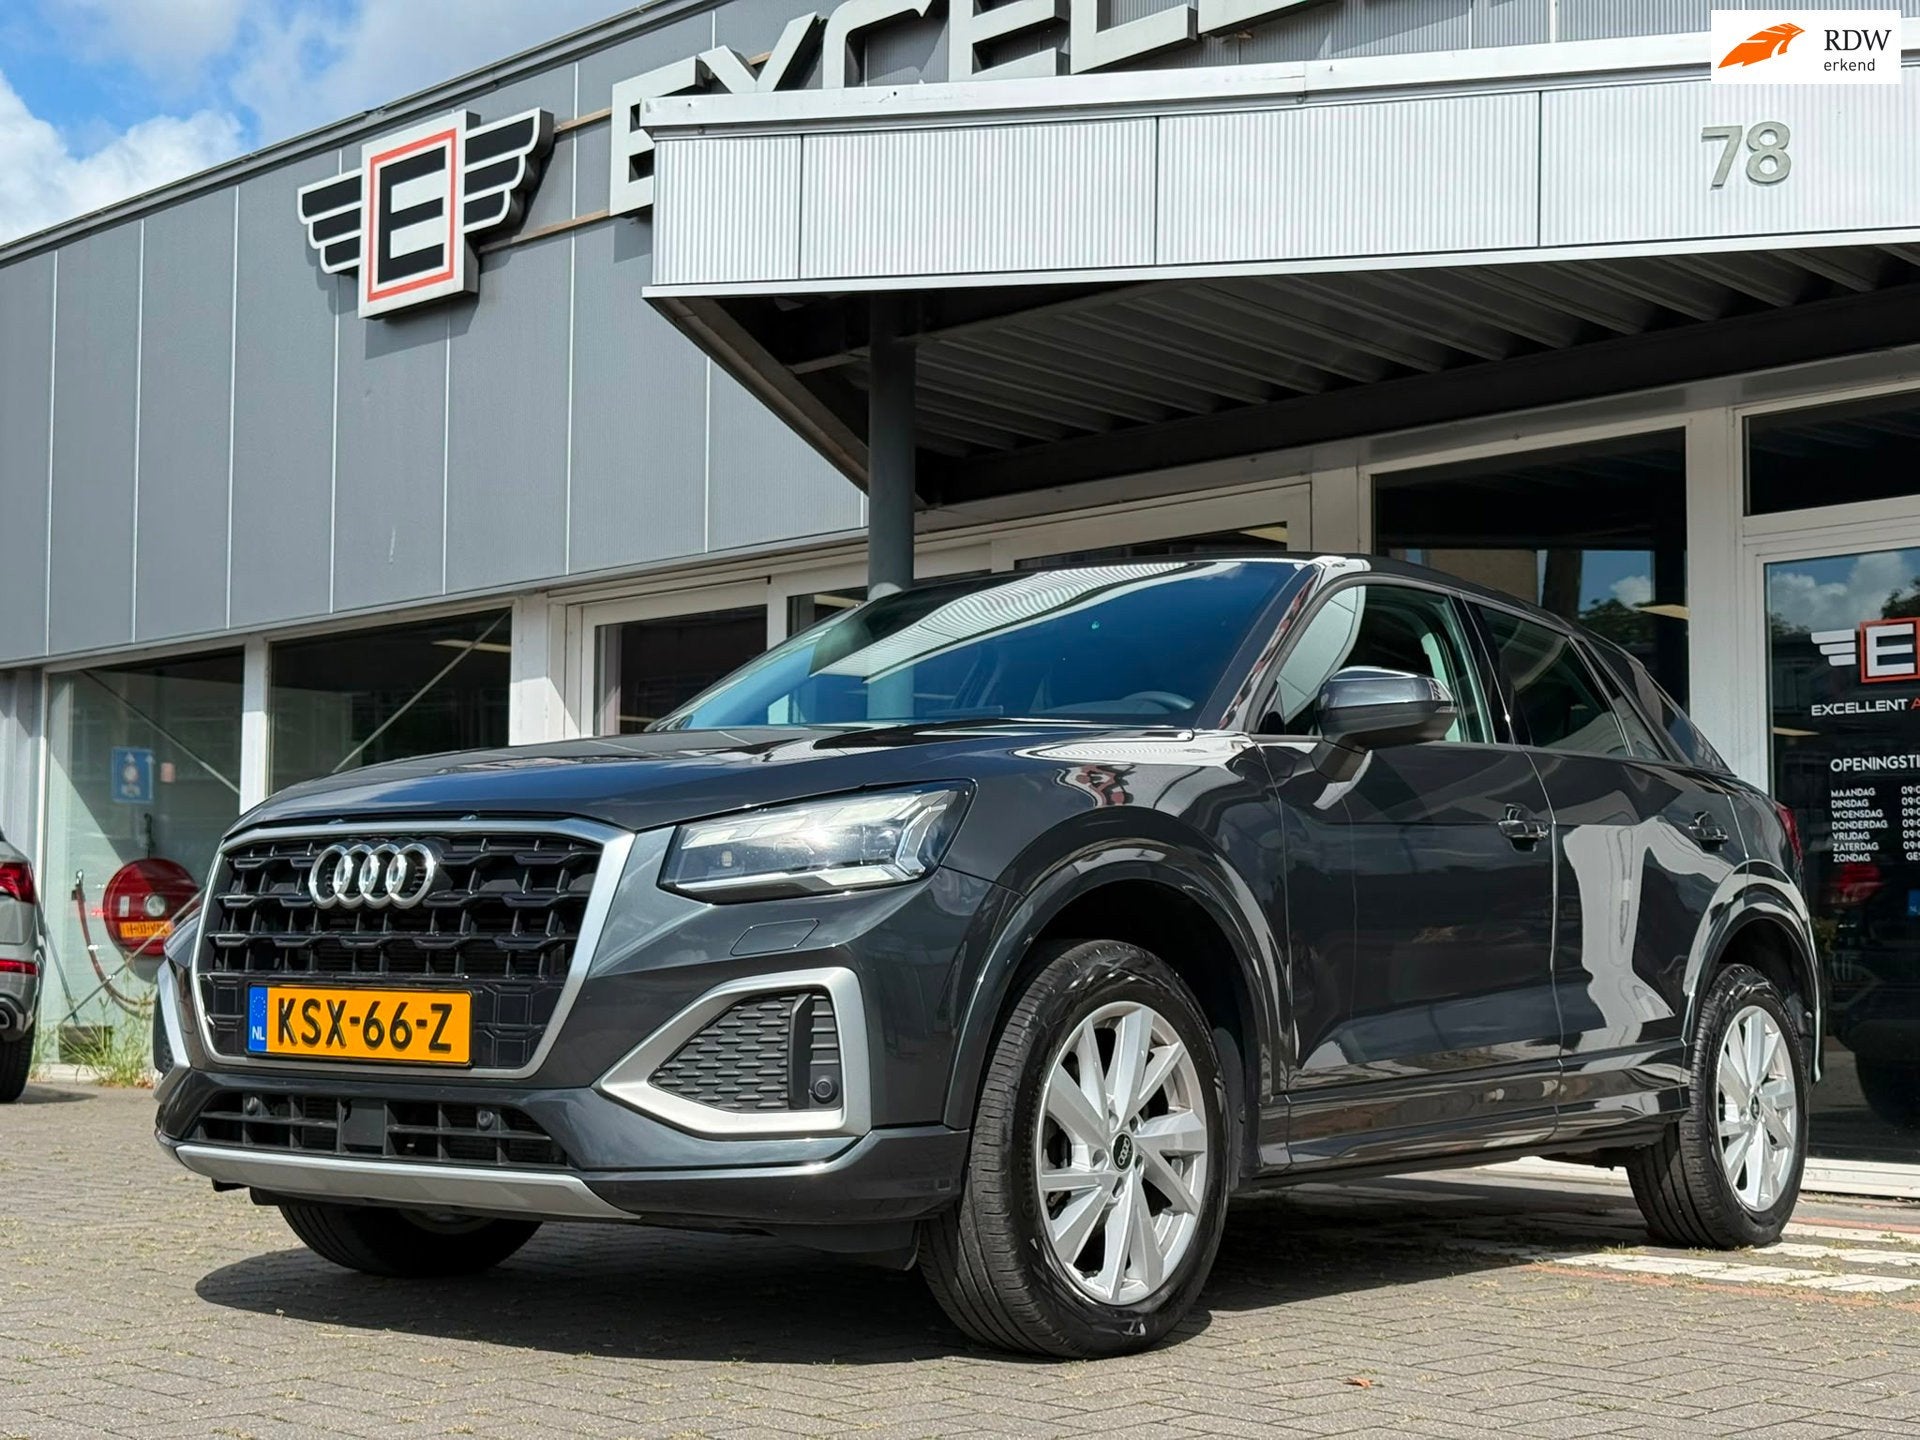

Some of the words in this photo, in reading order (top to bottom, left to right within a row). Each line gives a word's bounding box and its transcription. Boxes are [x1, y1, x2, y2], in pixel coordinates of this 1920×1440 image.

[1701, 121, 1792, 190] 78
[376, 145, 447, 285] E
[1866, 623, 1915, 677] E
[1811, 698, 1909, 716] EXCELLENT
[1830, 787, 1876, 797] MAANDAG
[1831, 798, 1869, 808] DINSDAG
[1831, 809, 1884, 819] WOENSDAG
[1831, 820, 1888, 830] DONDERDAG
[1832, 831, 1870, 841] VRIJDAG
[1832, 842, 1879, 852] ZATERDAG
[1833, 853, 1871, 863] ZONDAG
[278, 997, 453, 1054] KSX-66-Z
[252, 1026, 265, 1041] NL
